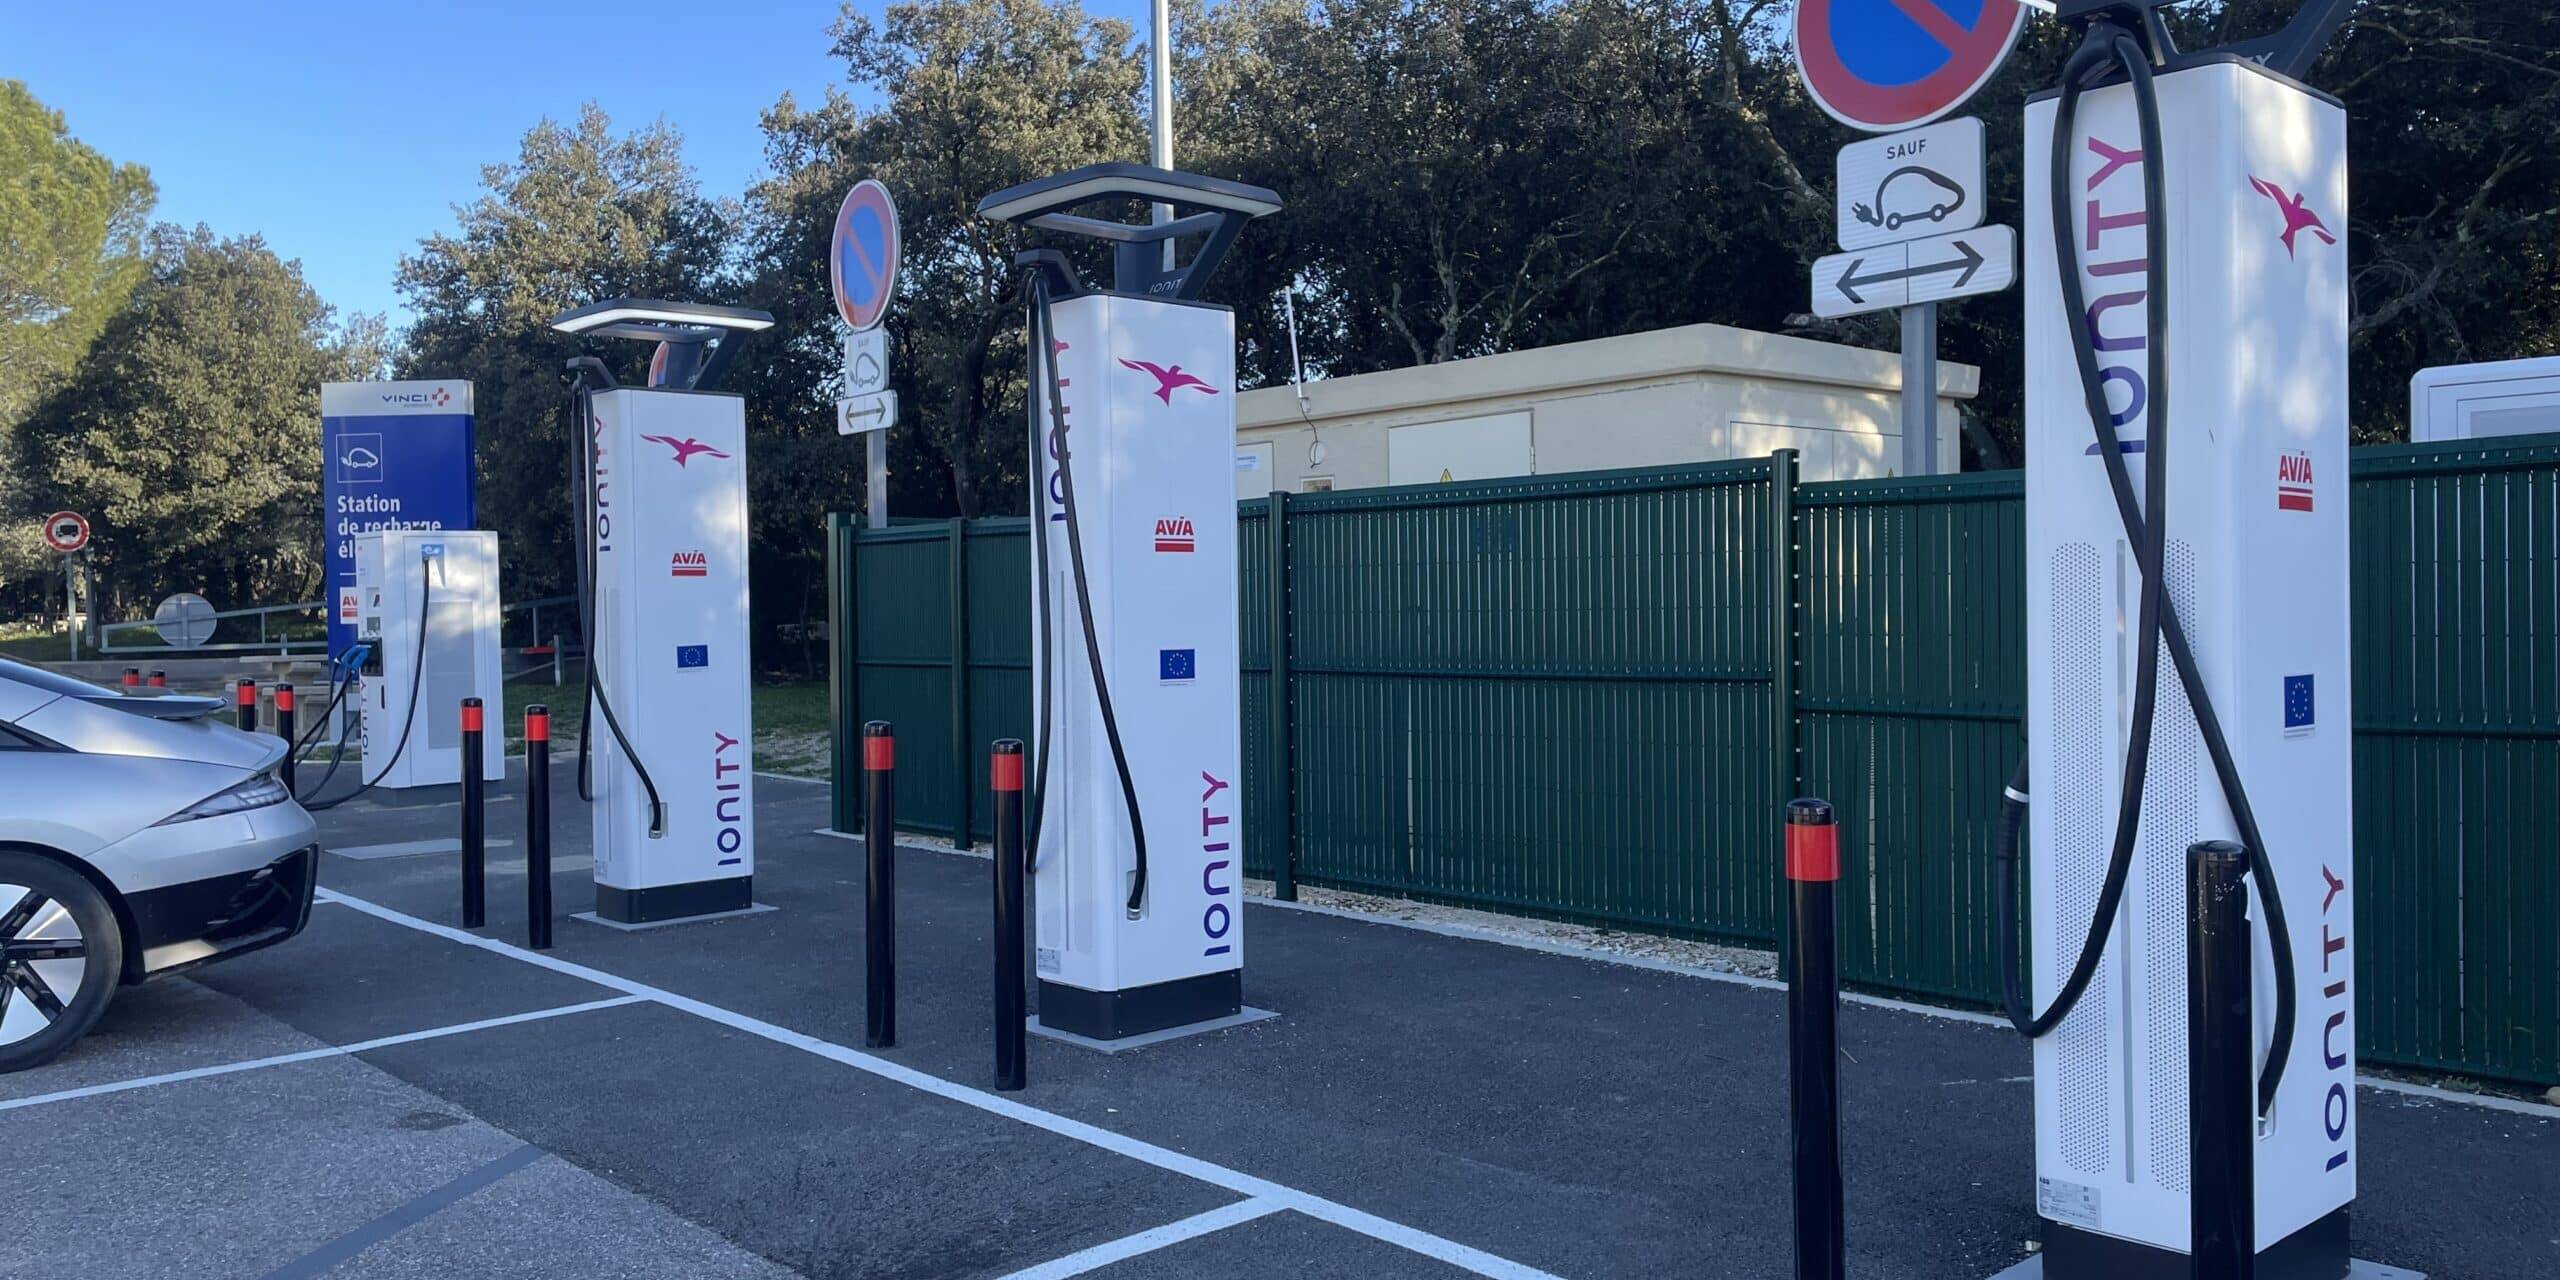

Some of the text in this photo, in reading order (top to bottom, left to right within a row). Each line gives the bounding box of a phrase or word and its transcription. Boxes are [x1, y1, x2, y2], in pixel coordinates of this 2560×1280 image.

[1887, 139, 1926, 159] SAUF
[1149, 278, 1183, 294] IONIT
[2084, 136, 2147, 456] IONITY
[382, 394, 428, 403] VINCI
[338, 494, 400, 513] Station
[338, 517, 359, 536] de
[715, 731, 742, 866] IONITY
[1202, 770, 1231, 957] IONITY
[2323, 863, 2348, 1172] IONITY
